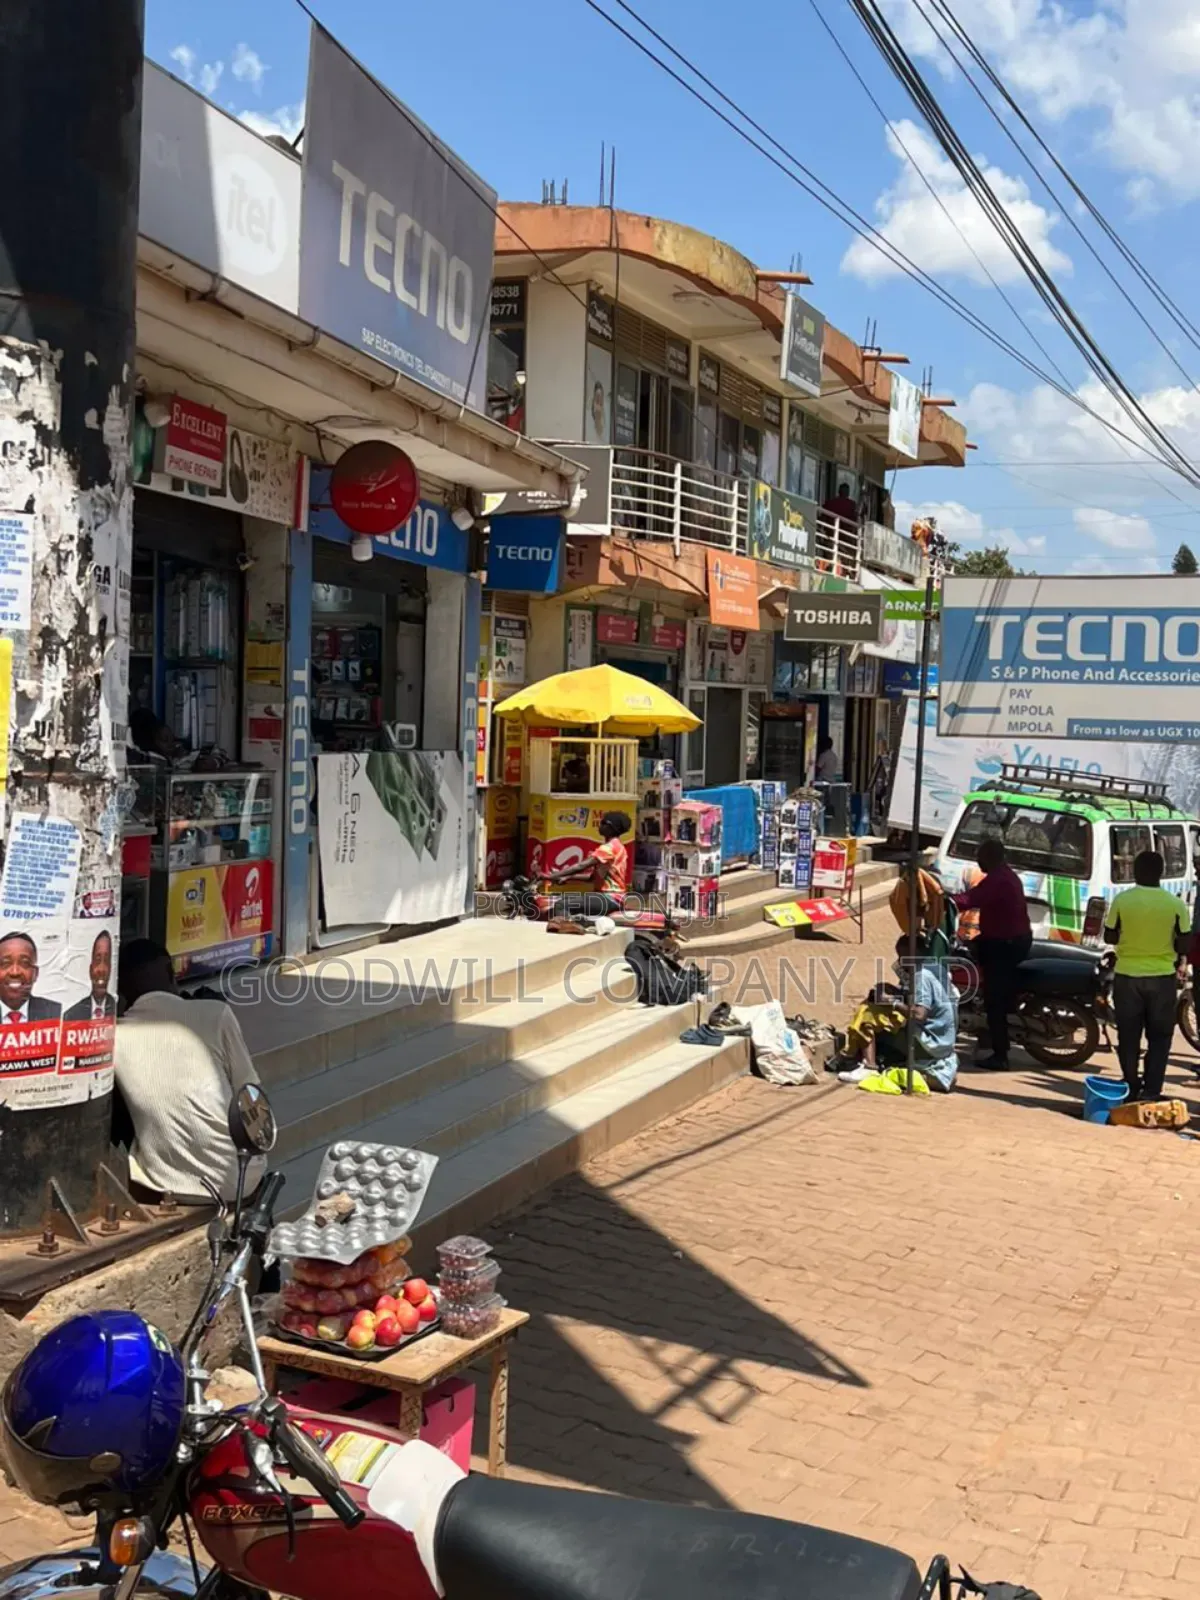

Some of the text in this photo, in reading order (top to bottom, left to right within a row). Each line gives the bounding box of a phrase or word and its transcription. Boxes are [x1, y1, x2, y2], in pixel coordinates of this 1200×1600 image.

[227, 172, 277, 255] itel
[332, 160, 473, 345] TECNO
[172, 402, 224, 442] EXCELLENT
[168, 454, 218, 481] PHONE REPAIR
[495, 545, 553, 562] TECNO
[793, 609, 872, 625] TOSHIBA
[975, 615, 1200, 663] TECNO
[991, 666, 1000, 680] S
[1003, 666, 1015, 680] &
[1018, 667, 1028, 680] P
[1032, 666, 1080, 681] Phone
[1083, 667, 1116, 682] And
[1009, 688, 1033, 699] PAY
[1008, 705, 1054, 716] MPOLA
[1007, 721, 1053, 733] MPOLA
[1073, 725, 1102, 736] From
[1105, 728, 1117, 736] as
[1119, 725, 1140, 737] low
[1142, 729, 1155, 737] as
[1157, 726, 1184, 738] UGX
[291, 657, 309, 834] TECNO
[241, 899, 263, 919] airtel
[31, 1056, 56, 1068] WEST
[203, 1503, 286, 1521] BOXER
